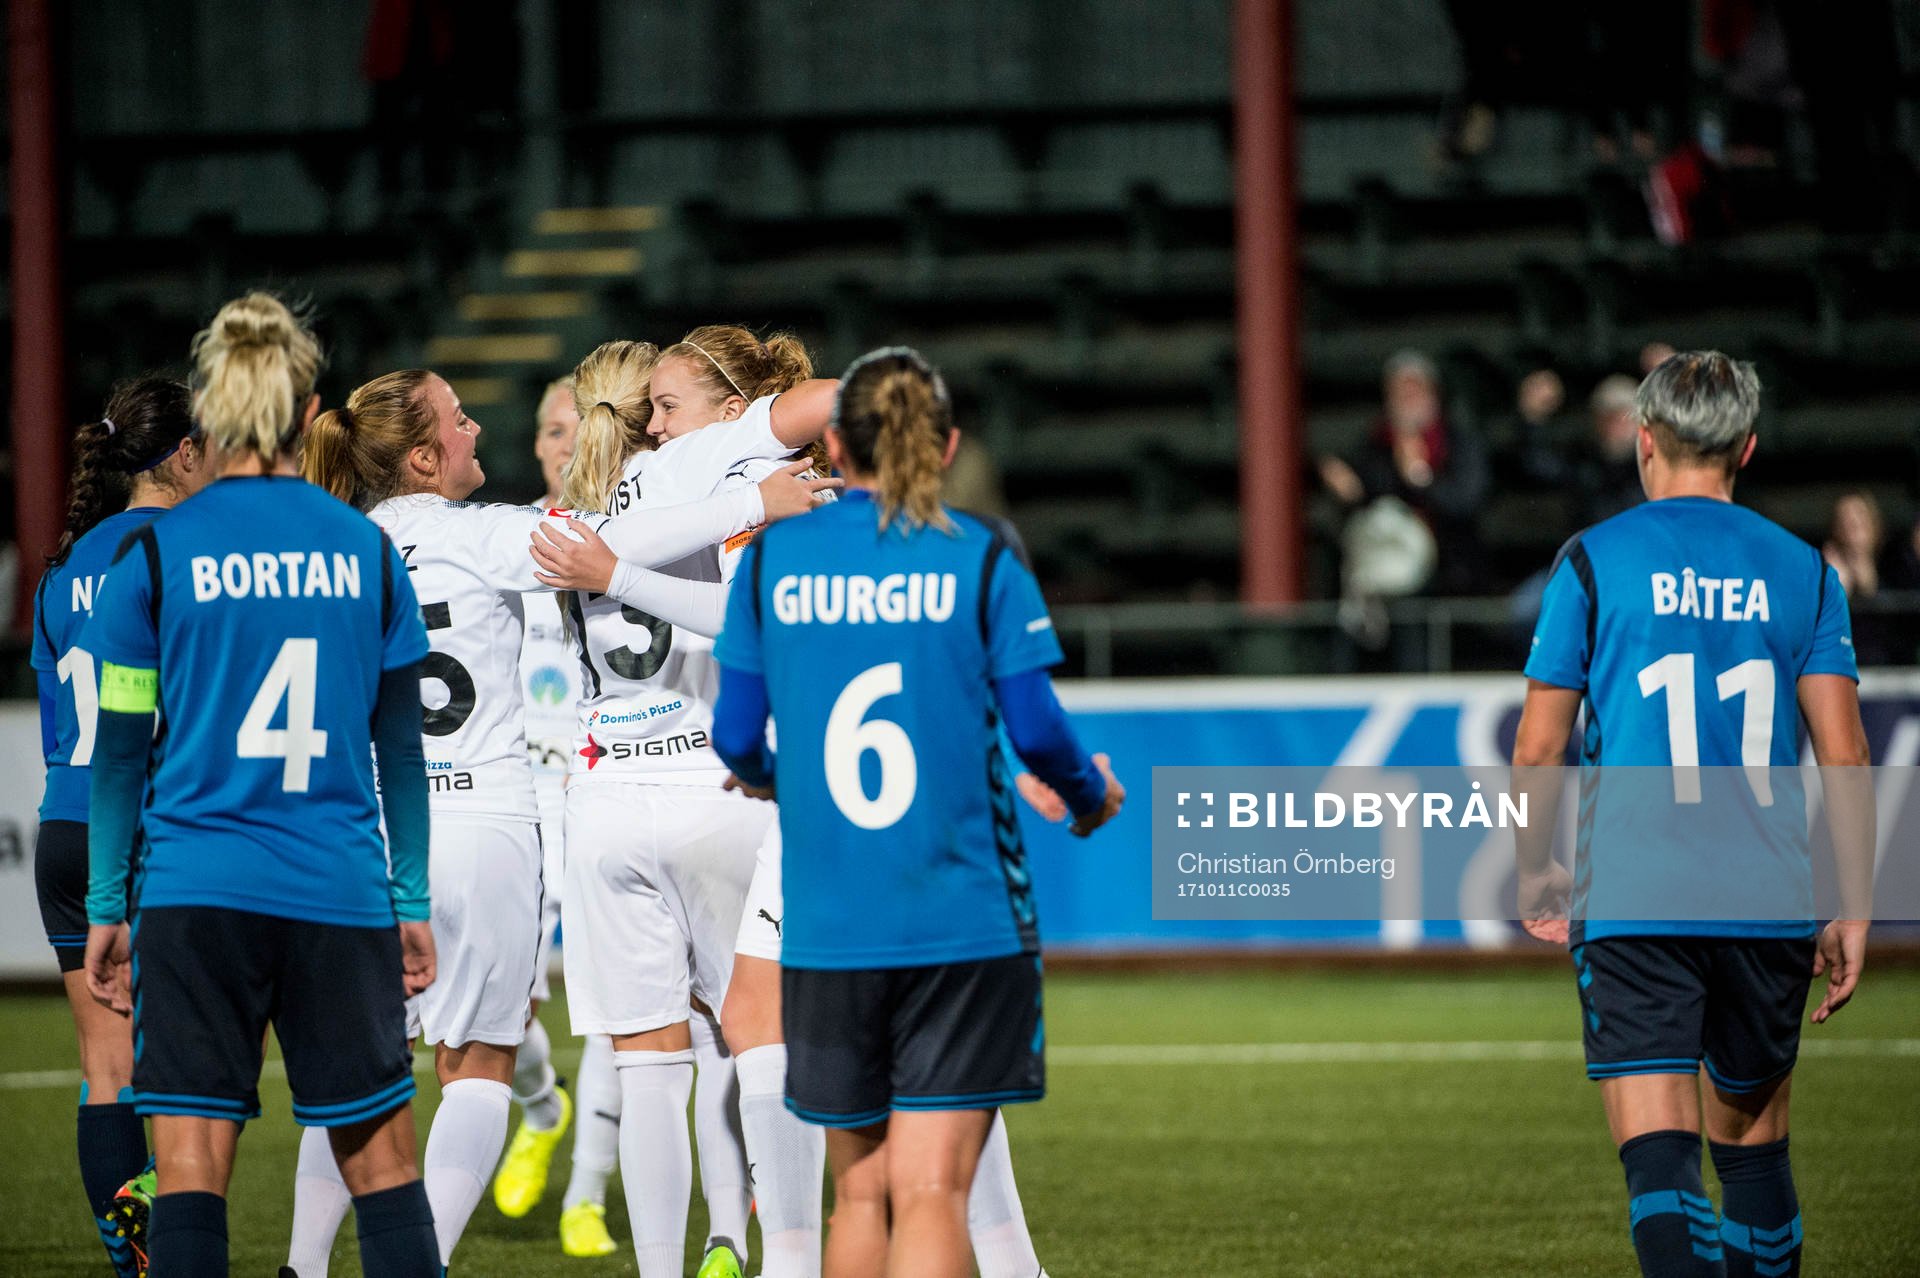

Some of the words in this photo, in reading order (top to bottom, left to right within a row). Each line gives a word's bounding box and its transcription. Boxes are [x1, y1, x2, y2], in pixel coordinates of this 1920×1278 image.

[191, 551, 361, 603] BORTAN
[772, 573, 957, 625] GIURGIU
[1651, 567, 1770, 622] BÂTEA
[236, 637, 328, 793] 4
[600, 708, 648, 725] Domino's
[649, 699, 683, 717] Pizza
[1637, 652, 1775, 808] 11
[824, 662, 918, 830] 6
